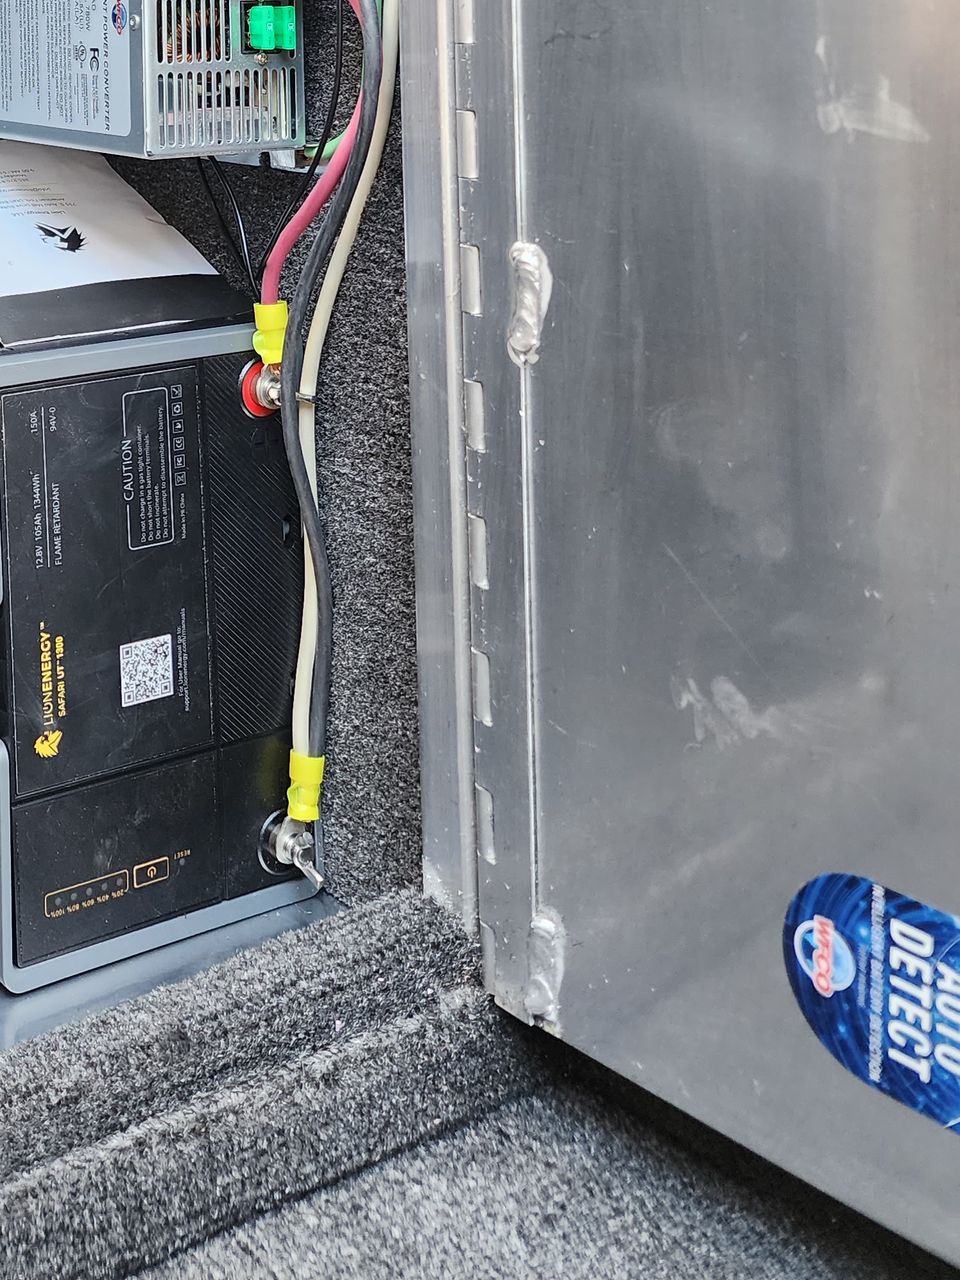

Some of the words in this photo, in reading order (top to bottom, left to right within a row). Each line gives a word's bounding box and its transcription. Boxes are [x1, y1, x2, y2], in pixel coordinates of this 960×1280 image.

[29, 410, 38, 433] 150A
[48, 406, 57, 431] 94V-0
[121, 439, 134, 500] CAUTION
[31, 473, 41, 509] 1344Wh
[50, 481, 61, 534] RETARDANT
[33, 512, 42, 541] 105Ah
[140, 532, 146, 542] Do
[148, 531, 153, 540] Do
[155, 530, 160, 539] Do
[163, 528, 168, 537] Do
[34, 544, 43, 568] 12.8V
[53, 535, 62, 565] FLAME
[55, 635, 63, 658] 1300
[57, 681, 65, 716] SAFARI
[173, 848, 190, 859] RESET
[81, 898, 94, 907] 60%
[96, 894, 109, 903] 40%
[111, 889, 124, 899] 20%
[50, 908, 64, 916] 100%
[66, 902, 79, 912] 80%
[870, 884, 885, 960] INTELLIGENT
[812, 916, 833, 997] WFCO
[869, 958, 884, 1014] BATTERY
[887, 918, 934, 1084] DETECT
[868, 1012, 883, 1082] DETECTION
